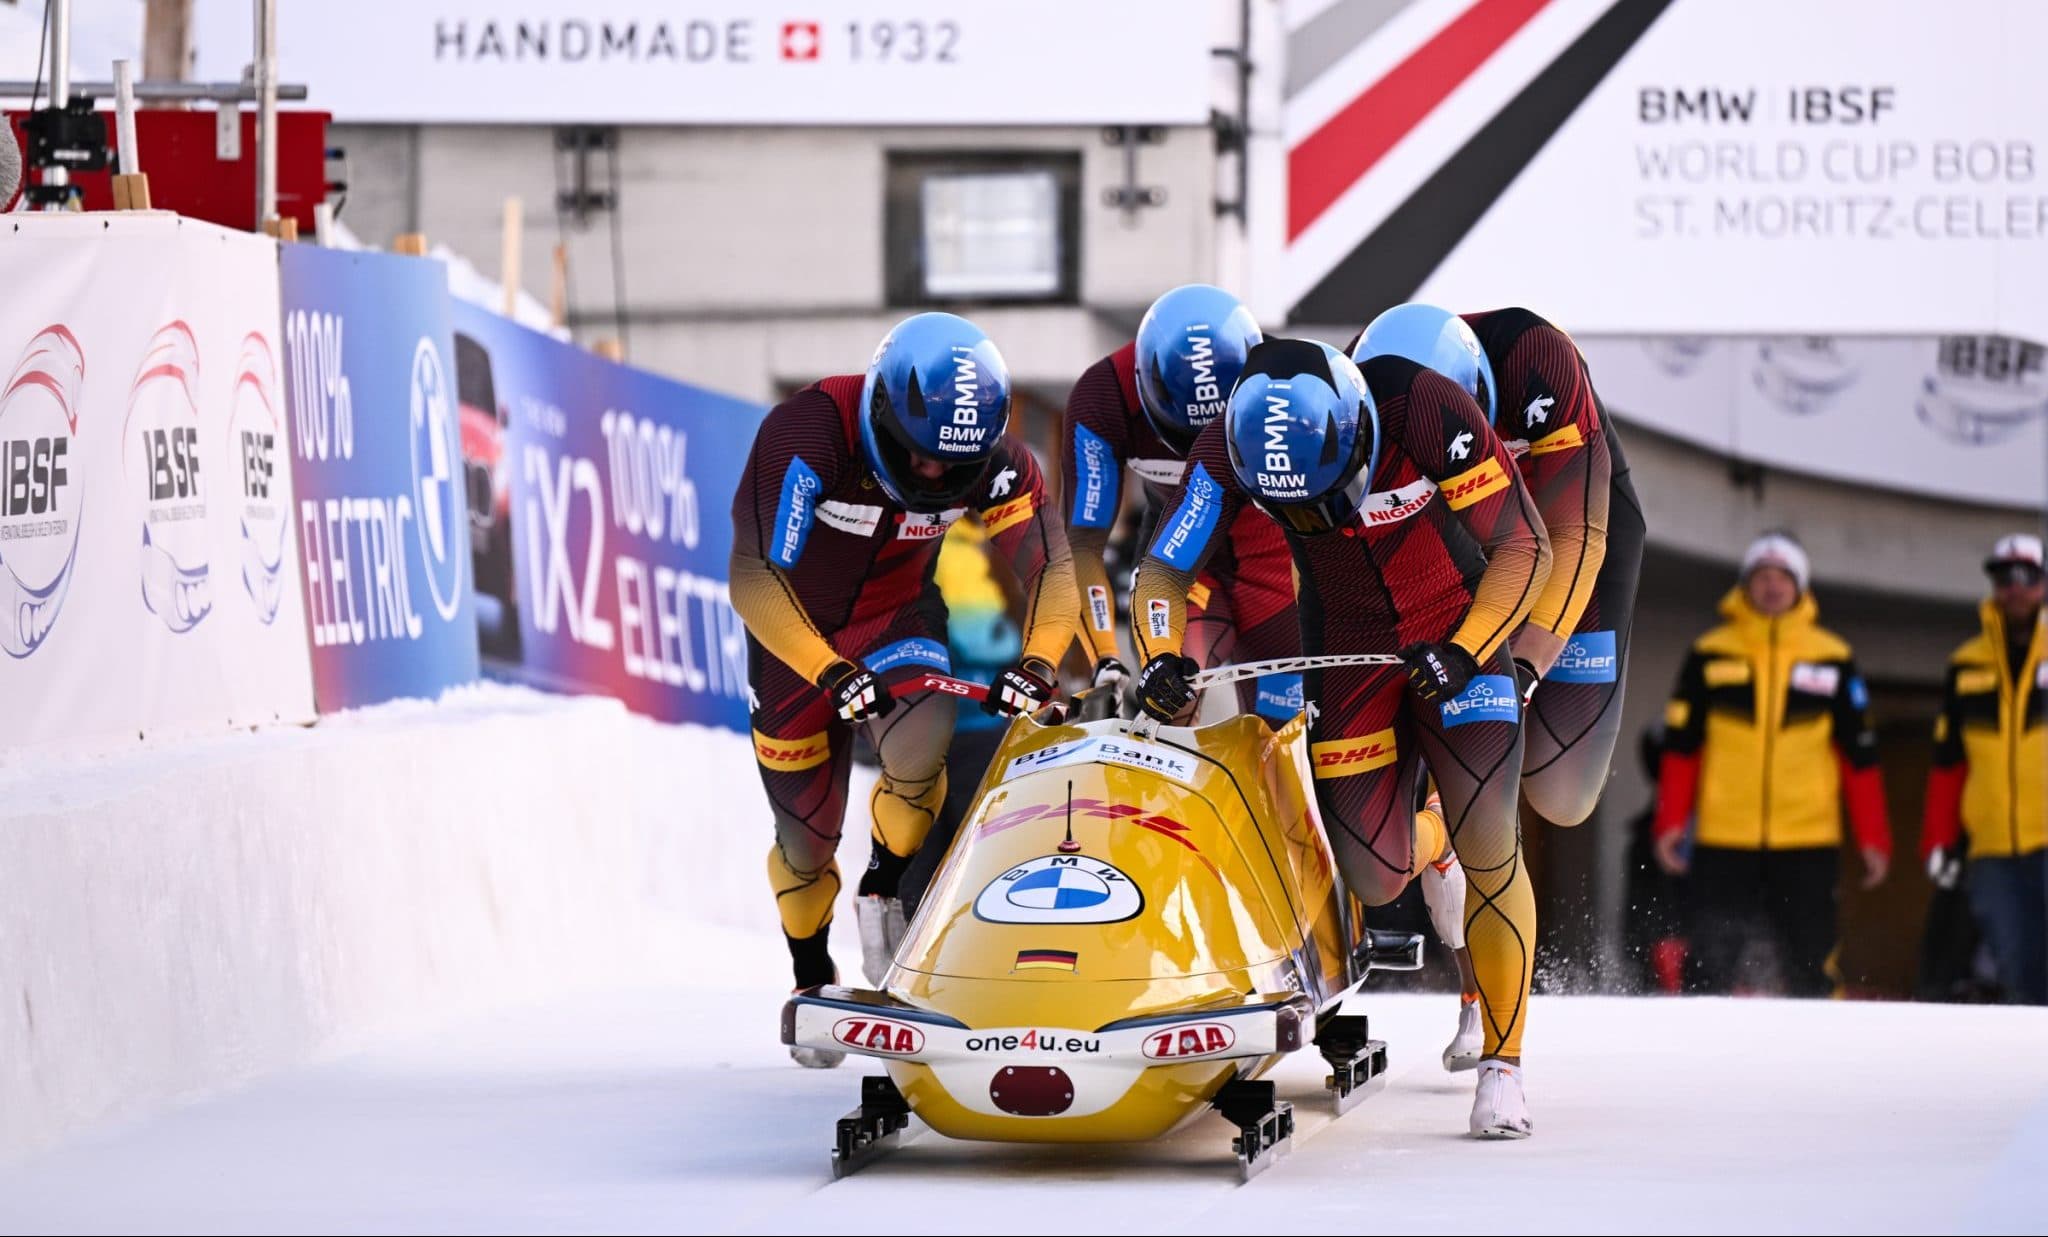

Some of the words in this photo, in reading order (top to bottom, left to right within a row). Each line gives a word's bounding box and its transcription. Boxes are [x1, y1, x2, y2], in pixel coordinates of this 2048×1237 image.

[434, 20, 752, 62] HANDMADE
[847, 21, 960, 62] 1932
[1638, 87, 1756, 123] BMW
[1789, 88, 1895, 123] IBSF
[1634, 140, 1808, 183] WORLD
[1822, 140, 1918, 182] CUP
[1933, 140, 2036, 182] BOB
[1634, 197, 1700, 239] ST.
[287, 310, 353, 462] 100%
[1188, 337, 1220, 402] BMW
[952, 357, 979, 426] BMW
[1187, 401, 1228, 417] BMW
[938, 441, 982, 453] helmets
[939, 426, 986, 442] BMW
[1264, 396, 1292, 472] BMW
[2, 437, 68, 517] IBSF
[143, 427, 200, 502] IBSF
[241, 431, 275, 499] IBSF
[602, 410, 699, 550] 100%
[1257, 472, 1306, 488] BMW
[1261, 487, 1309, 498] helmets
[1444, 472, 1494, 501] DHL
[1369, 490, 1433, 523] NIGRIN
[524, 443, 614, 651] iX2
[905, 525, 950, 538] NIGR
[301, 494, 424, 647] ELECTRIC
[615, 555, 750, 699] ELECTR
[1003, 671, 1039, 697] SEIZ
[1138, 661, 1164, 689] SEIZ
[1425, 652, 1450, 685] SEIZ
[840, 672, 873, 703] SEIZ
[759, 745, 816, 761] DHL
[1015, 746, 1059, 767] BB
[1099, 743, 1186, 773] Bank
[1319, 743, 1386, 767] DHL
[1001, 857, 1126, 883] BMW
[842, 1022, 916, 1055] ZAA
[966, 1029, 1101, 1053] one4u.eu
[1150, 1024, 1227, 1058] ZAA
